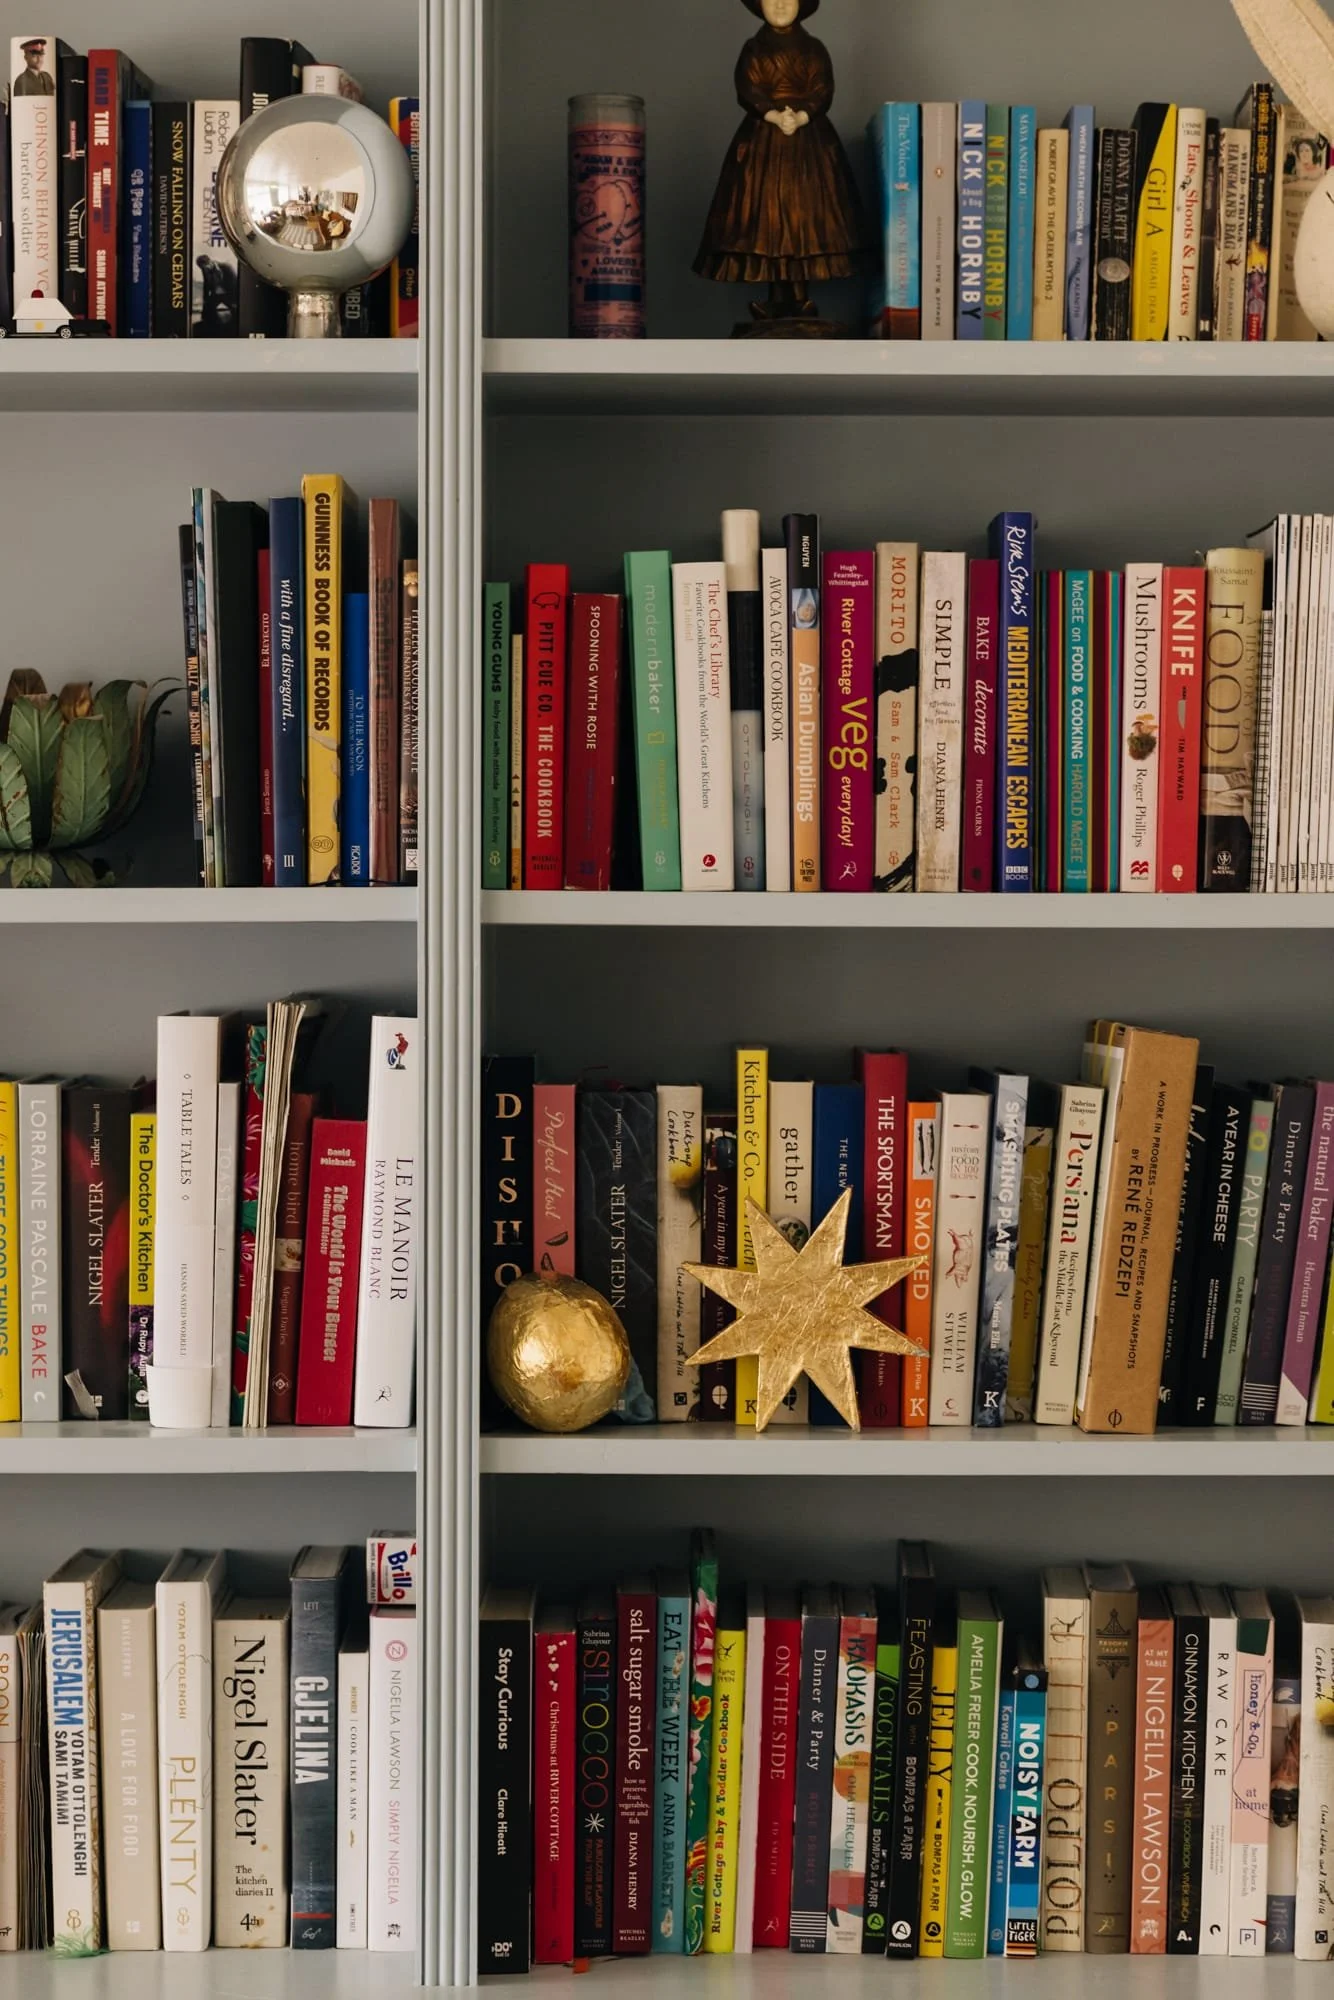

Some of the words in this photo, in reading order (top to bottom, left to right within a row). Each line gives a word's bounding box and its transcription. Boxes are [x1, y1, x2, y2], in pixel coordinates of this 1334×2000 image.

[33, 106, 48, 181] JOHNSON
[94, 111, 108, 145] TIME
[172, 121, 183, 162] SNOW
[898, 114, 910, 139] The
[1019, 114, 1029, 143] MAYA
[20, 142, 32, 199] barefoot
[898, 140, 909, 177] Voices
[962, 123, 983, 180] NICK
[1018, 146, 1028, 198] ANGELOU
[1078, 155, 1086, 187] BREATH
[1116, 137, 1130, 188] DONNA
[159, 176, 168, 204] DAVID
[172, 168, 183, 225] FALLING
[1077, 190, 1085, 230] BECOMES
[1147, 169, 1166, 210] Girl
[21, 208, 32, 254] soldier
[36, 187, 47, 260] BEHARRY
[159, 206, 168, 254] GUTERSON
[1115, 195, 1128, 243] TARTT
[1146, 222, 1165, 237] A
[1184, 190, 1196, 239] Shoots
[1224, 224, 1235, 249] BAG
[172, 229, 183, 249] ON
[1184, 246, 1194, 258] &
[172, 254, 183, 308] CEDARS
[961, 216, 981, 320] HORNBY
[1180, 265, 1193, 315] Leaves
[314, 493, 330, 571] GUINNESS
[802, 536, 810, 567] NGUYEN
[280, 579, 293, 607] with
[280, 610, 291, 619] a
[314, 578, 330, 625] BOOK
[708, 580, 721, 605] The
[769, 576, 782, 617] AVOCA
[891, 557, 905, 644] MORITO
[1072, 580, 1085, 623] McGEE
[278, 621, 293, 650] fine
[314, 630, 330, 652] OF
[491, 601, 503, 649] YOUNG
[539, 622, 553, 653] PITT
[587, 606, 600, 671] SPOONING
[709, 608, 722, 649] Chef's
[770, 621, 784, 656] CAFÉ
[935, 600, 951, 689] SIMPLE
[1072, 627, 1082, 642] on
[1133, 576, 1156, 709] Mushrooms
[1172, 588, 1196, 675] KNIFE
[491, 654, 503, 692] GUMS
[539, 661, 553, 688] CUE
[709, 653, 722, 698] Library
[1072, 646, 1085, 681] FOOD
[314, 658, 330, 730] RECORDS
[355, 695, 364, 708] TO
[537, 695, 552, 718] CO.
[587, 676, 599, 711] WITH
[771, 661, 783, 741] COOKBOOK
[799, 663, 815, 715] Asian
[1007, 626, 1028, 766] MEDITERRANEAN
[1072, 686, 1084, 695] &
[355, 712, 364, 732] THE
[537, 725, 553, 751] THE
[586, 716, 598, 749] ROSIE
[891, 702, 901, 727] Sam
[1072, 699, 1084, 759] COOKING
[355, 737, 364, 770] MOON
[797, 721, 816, 821] Dumplings
[891, 752, 901, 778] Sam
[936, 742, 946, 784] DIANA
[537, 759, 552, 838] COOKBOOK
[1134, 768, 1148, 801] Roger
[1177, 757, 1185, 800] HAYWARD
[890, 786, 901, 828] Clark
[935, 789, 945, 831] HENRY
[974, 806, 982, 836] CAIRNS
[1007, 775, 1028, 848] ESCAPES
[1133, 806, 1147, 847] Phillips
[351, 846, 360, 875] PICADOR
[180, 1089, 193, 1136] TABLE
[743, 1061, 760, 1125] Kitchen
[878, 1096, 894, 1132] THE
[1228, 1106, 1238, 1117] A
[30, 1100, 46, 1210] LORRAINE
[140, 1125, 152, 1155] The
[744, 1130, 758, 1146] &
[998, 1102, 1019, 1202] SMASHING
[1222, 1119, 1237, 1160] YEAR
[180, 1141, 193, 1185] TALES
[396, 1158, 413, 1186] LE
[743, 1153, 759, 1181] Co.
[781, 1128, 801, 1204] gather
[1221, 1165, 1233, 1179] IN
[139, 1160, 152, 1226] Doctor's
[371, 1159, 385, 1239] RAYMOND
[876, 1137, 893, 1247] SPORTSMAN
[1060, 1132, 1091, 1243] Persiana
[1125, 1165, 1146, 1212] RENÉ
[89, 1182, 103, 1246] SLATER
[1213, 1184, 1231, 1242] CHEESE
[138, 1231, 152, 1292] Kitchen
[390, 1196, 411, 1300] MANOIR
[994, 1207, 1012, 1272] PLATES
[1114, 1222, 1135, 1297] REDZEPI
[31, 1220, 46, 1313] PASCALE
[89, 1256, 103, 1305] NIGEL
[368, 1247, 383, 1298] BLANC
[32, 1325, 46, 1379] BAKE
[942, 1312, 954, 1372] SITWELL
[955, 1312, 966, 1373] WILLIAM
[388, 1550, 413, 1600] Brillo
[630, 1609, 648, 1643] salt
[52, 1609, 83, 1725] JERUSALEM
[223, 1636, 268, 1729] Nigel
[496, 1648, 512, 1684] Stay
[624, 1648, 644, 1701] sugar
[907, 1619, 926, 1715] FEASTING
[1183, 1634, 1199, 1723] CINNAMON
[390, 1670, 401, 1724] NIGELLA
[845, 1637, 867, 1746] KAUKASIS
[295, 1676, 329, 1784] GJELINA
[497, 1688, 512, 1750] Curious
[628, 1706, 647, 1770] smoke
[929, 1687, 954, 1784] JELLY
[1144, 1677, 1165, 1781] NIGELLA
[55, 1731, 69, 1767] SAMI
[71, 1731, 84, 1779] YOTAM
[389, 1731, 401, 1789] LAWSON
[872, 1686, 895, 1822] COCKTAILS
[1017, 1723, 1040, 1801] NOISY
[1181, 1730, 1196, 1799] KITCHEN
[57, 1772, 70, 1824] TAMIMI
[234, 1740, 268, 1846] Slater
[497, 1789, 508, 1818] Clare
[72, 1785, 86, 1876] OTTOLENGHI
[170, 1757, 196, 1895] PLENTY
[496, 1821, 507, 1855] Hieatt
[629, 1832, 637, 1867] DIANA
[1014, 1806, 1037, 1867] FARM
[1141, 1792, 1163, 1904] LAWSON
[628, 1872, 637, 1910] HENRY
